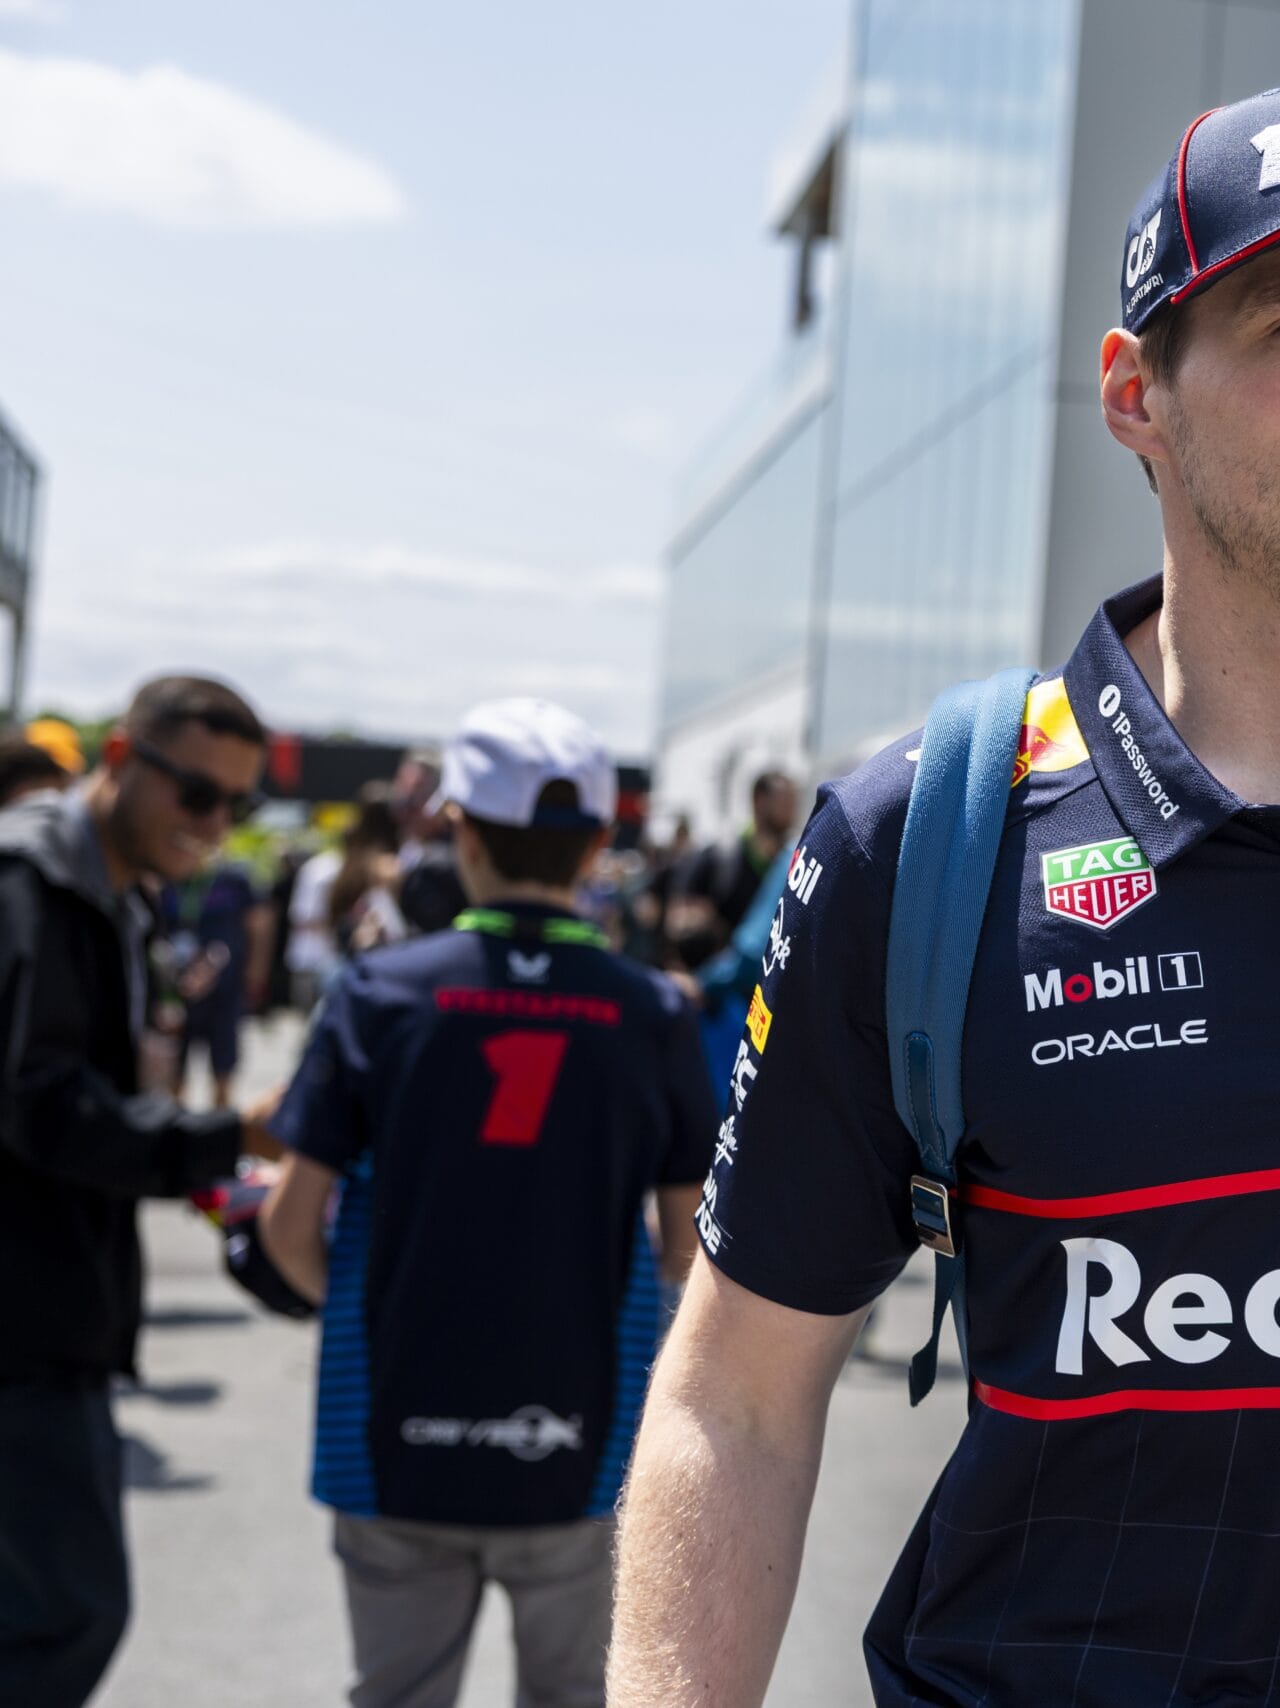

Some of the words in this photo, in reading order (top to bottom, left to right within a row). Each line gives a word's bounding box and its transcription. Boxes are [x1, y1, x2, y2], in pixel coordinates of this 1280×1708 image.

[1112, 711, 1180, 820] 1Password
[787, 845, 823, 905] bil
[1052, 841, 1143, 879] TAG
[1052, 875, 1149, 922] HEUER
[1024, 956, 1150, 1012] Mobil
[1031, 1019, 1208, 1065] ORACLE
[480, 1031, 569, 1145] 1
